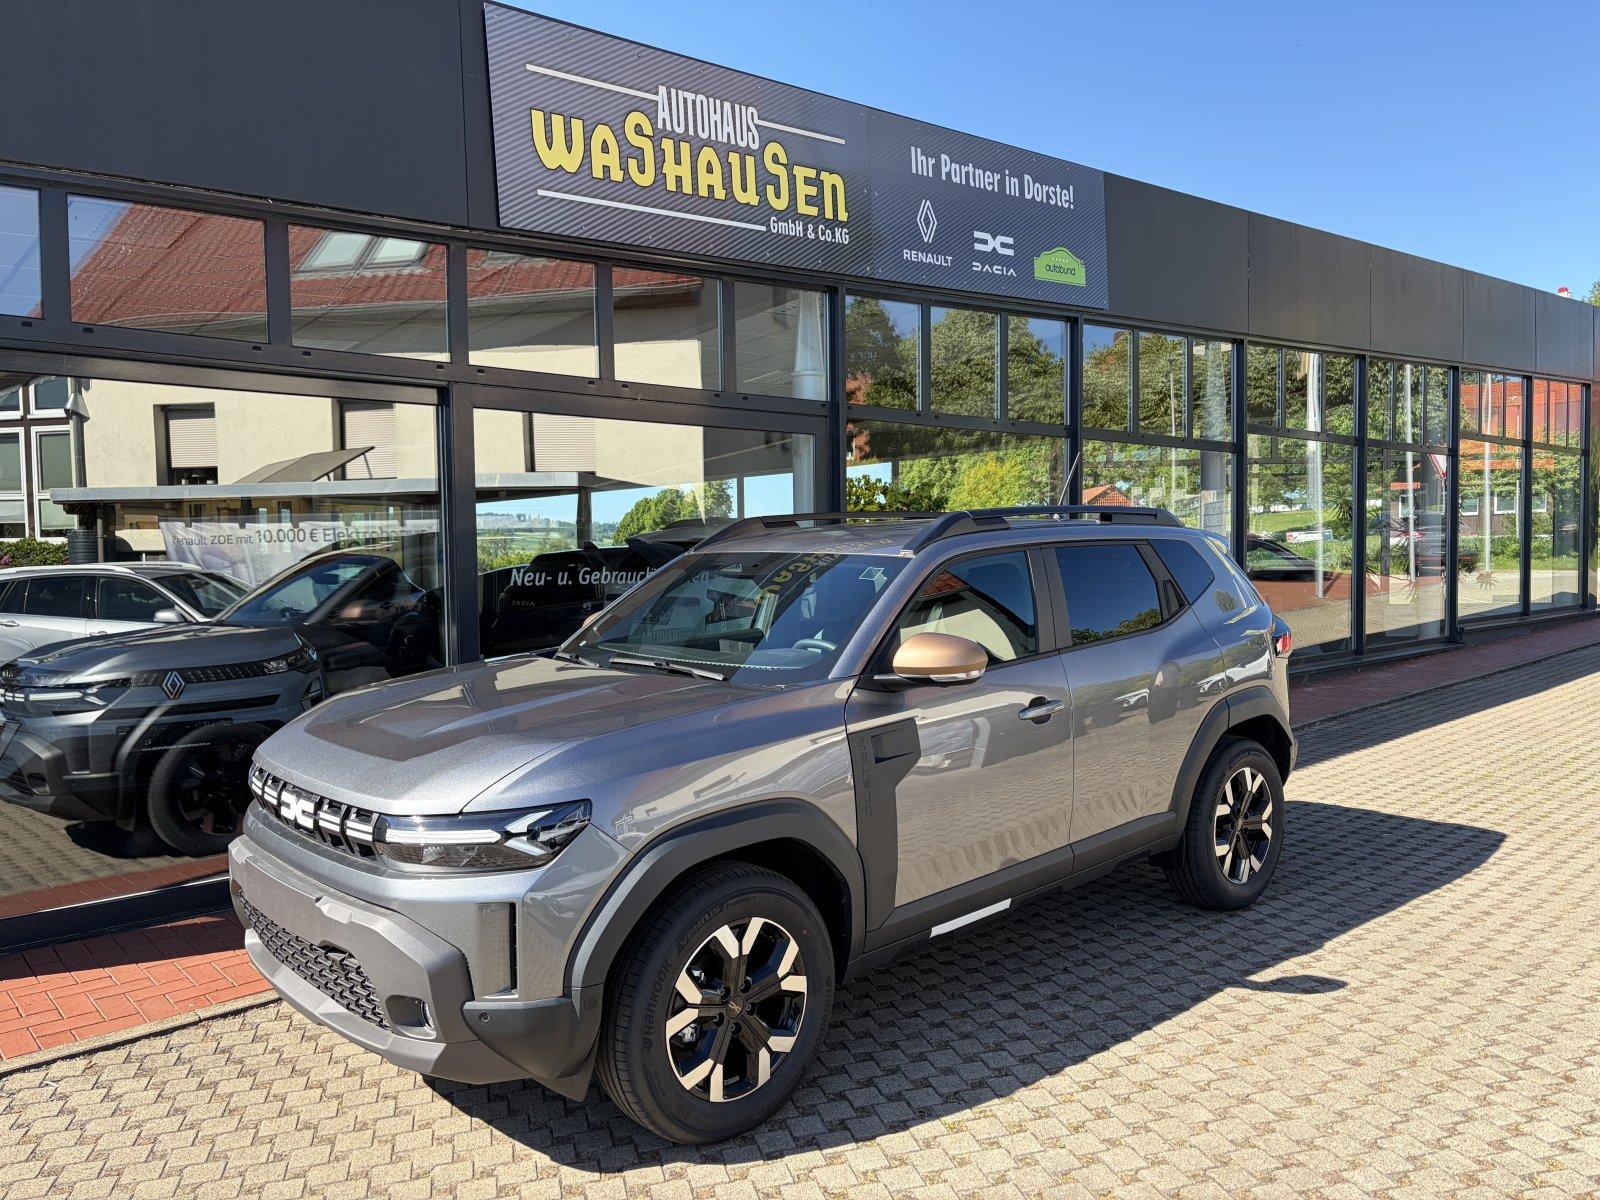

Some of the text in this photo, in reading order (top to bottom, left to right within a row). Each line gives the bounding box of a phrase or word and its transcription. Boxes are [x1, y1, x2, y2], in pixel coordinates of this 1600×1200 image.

[657, 85, 760, 150] AUTOHAUS
[911, 146, 1074, 209] Ihr Partner in Dorste!
[770, 216, 849, 244] GmbH & Co.KG
[903, 249, 953, 267] RENAULT
[972, 262, 1017, 277] DACIA
[1045, 263, 1076, 276] autobund
[210, 535, 233, 545] ZOE
[236, 534, 253, 545] mit
[255, 528, 306, 544] 10.000
[309, 528, 320, 543] €
[510, 566, 552, 586] Neu-
[558, 571, 572, 585] u.
